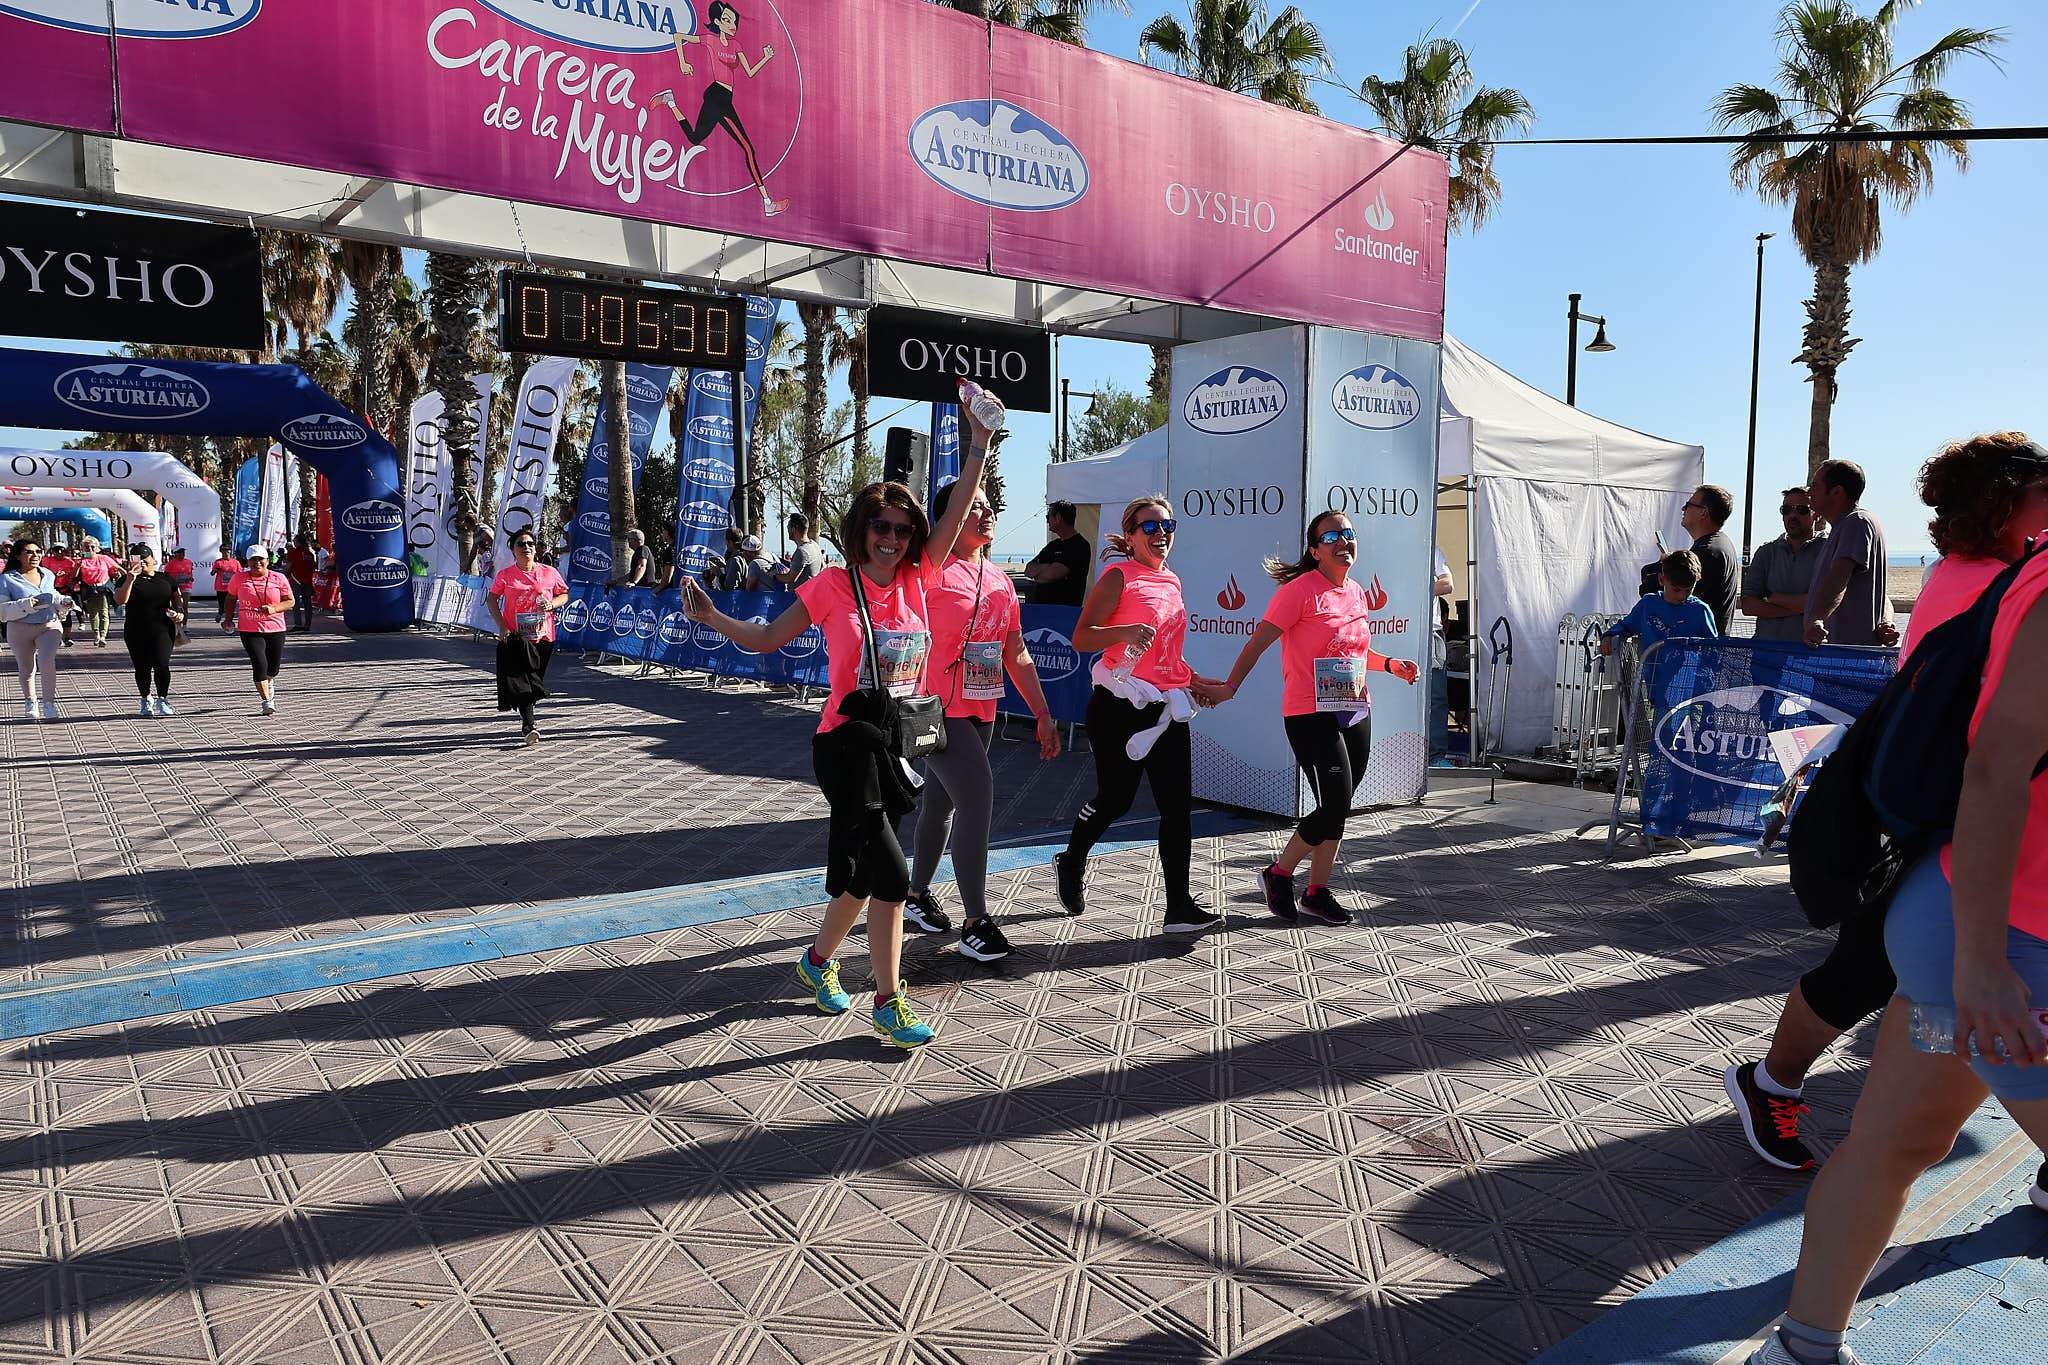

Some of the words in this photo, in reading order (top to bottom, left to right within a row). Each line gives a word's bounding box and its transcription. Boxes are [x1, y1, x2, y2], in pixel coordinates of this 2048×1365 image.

[427, 8, 635, 110] Carrera
[483, 86, 522, 130] de
[532, 92, 558, 140] la
[553, 99, 707, 203] Mujer
[924, 125, 1077, 194] ASTURIANA
[953, 128, 1010, 149] CENTRAL
[1016, 141, 1071, 162] LECHERA
[1165, 183, 1276, 233] OYSHO
[1334, 228, 1420, 266] Santander
[0, 246, 214, 308] YSHO
[522, 286, 729, 356] 01:05:30
[900, 338, 1027, 382] OYSHO
[67, 377, 199, 408] ASTURIANA
[90, 377, 140, 387] CENTRAL
[145, 382, 193, 390] LECHERA
[1205, 391, 1237, 399] CENTRAL
[1239, 384, 1277, 395] LECHERA
[1351, 385, 1380, 394] CENTRAL
[1190, 395, 1279, 420] ASTURIANA
[1337, 385, 1414, 416] ASTURIANA
[289, 426, 362, 441] ASTURIANA
[11, 455, 133, 479] OYSHO
[503, 384, 558, 537] OYSHO
[1183, 485, 1284, 517] OYSHO
[1327, 485, 1418, 516] OYSHO
[346, 512, 401, 524] ASTURIANA
[352, 569, 406, 581] ASTURIANA
[1190, 614, 1260, 637] Santand
[1369, 615, 1410, 636] ander
[915, 733, 937, 747] PUMA
